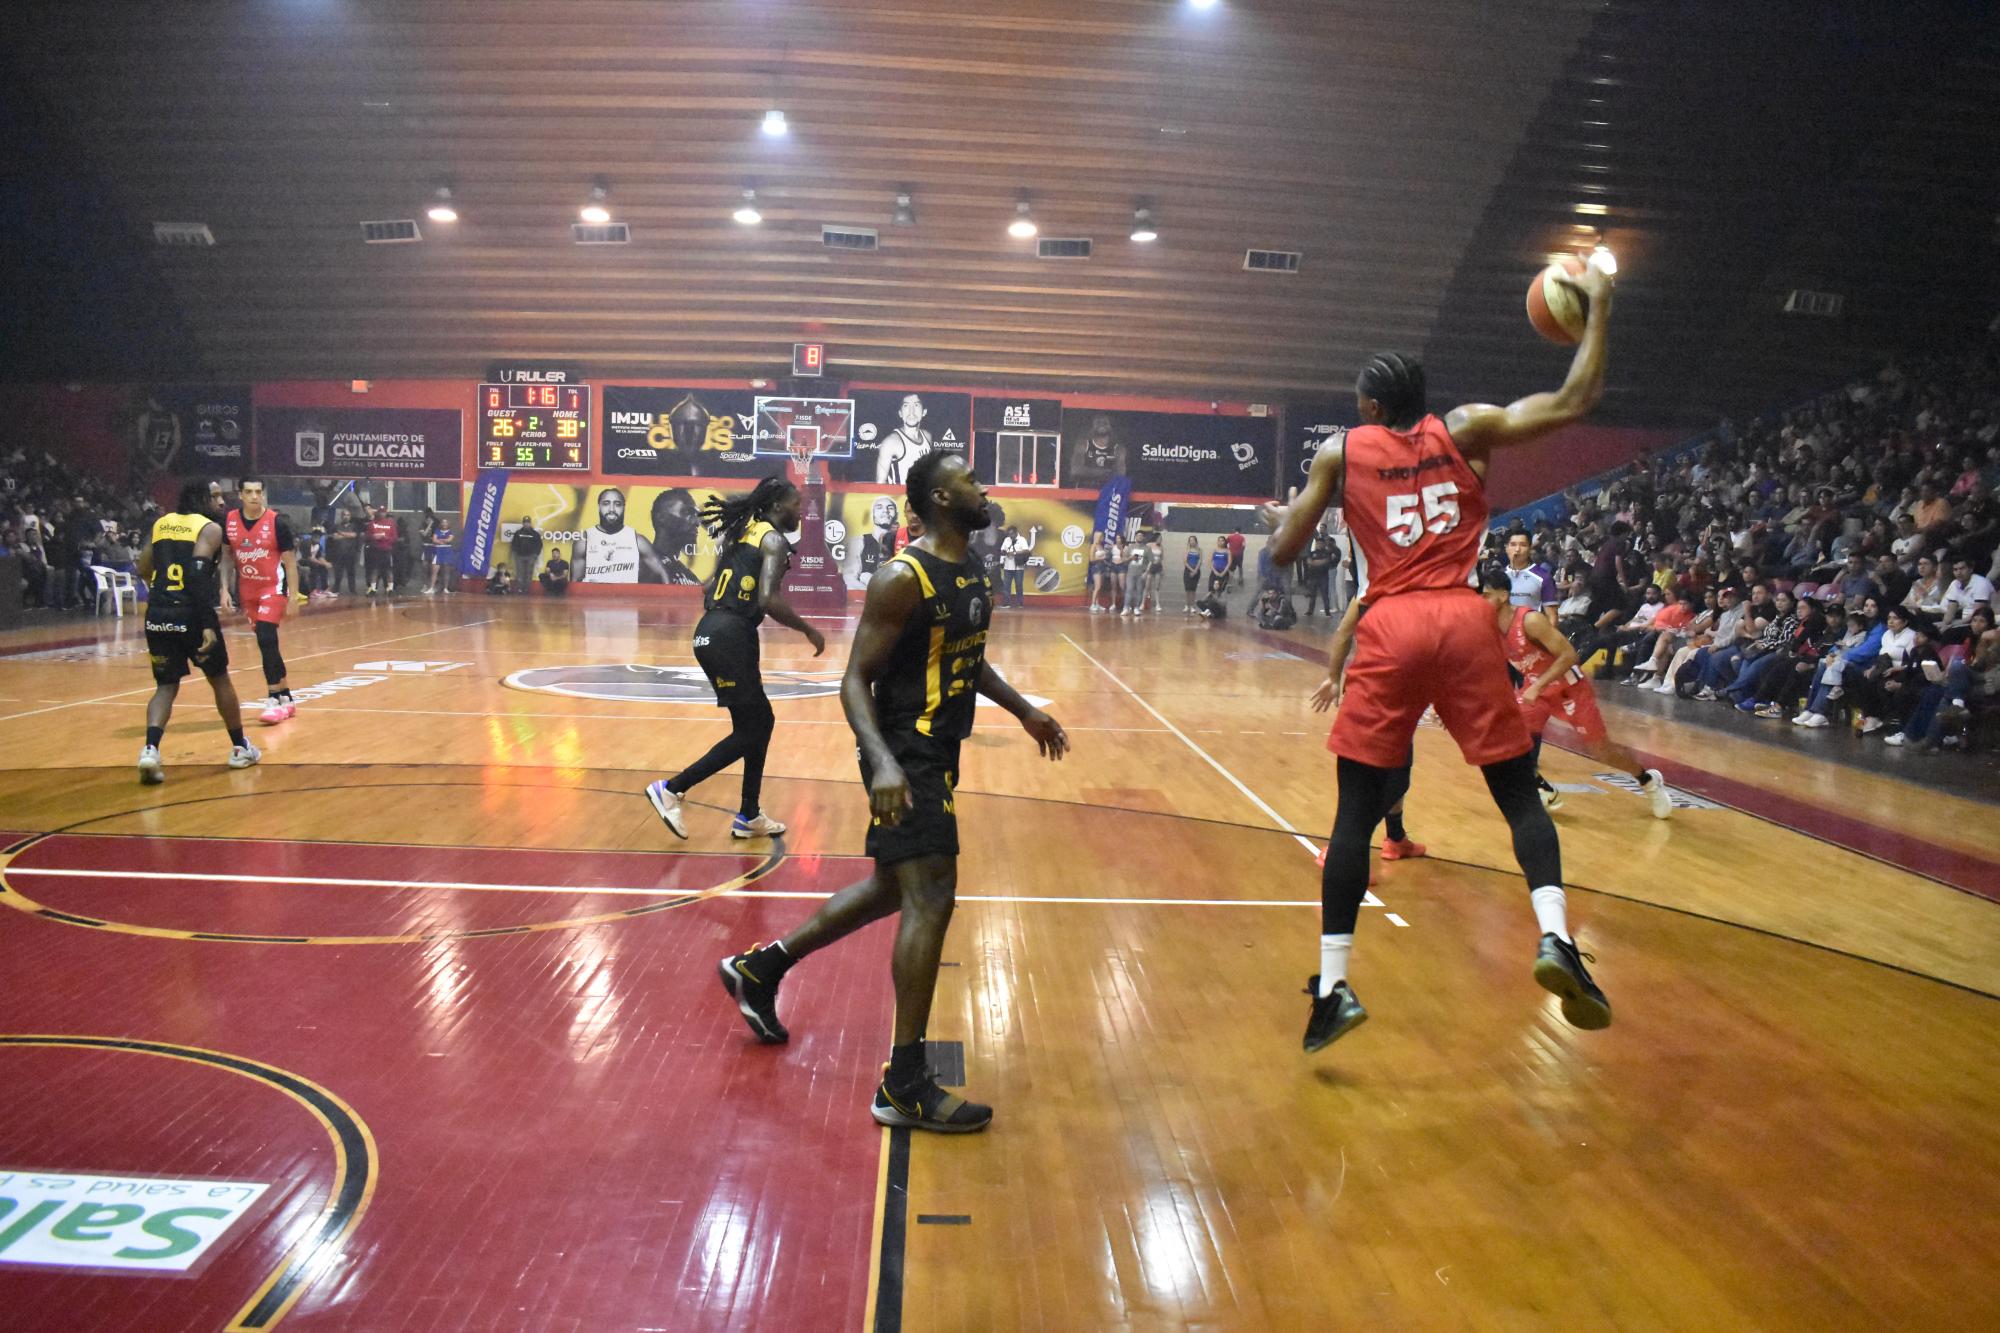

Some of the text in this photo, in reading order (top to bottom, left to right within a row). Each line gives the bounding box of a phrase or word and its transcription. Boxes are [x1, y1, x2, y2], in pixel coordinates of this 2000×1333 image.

[807, 347, 819, 365] 8
[516, 370, 566, 383] RULER
[490, 393, 500, 408] 0
[527, 386, 556, 405] 1:16
[487, 409, 517, 418] GUEST
[552, 410, 580, 419] HOME
[1004, 403, 1030, 417] ASÍ
[529, 416, 538, 430] 2
[611, 411, 652, 425] IMJU
[492, 418, 515, 437] 26
[556, 419, 578, 438] 38
[332, 432, 425, 443] AYUNTAMIENTO DE
[332, 442, 425, 458] CULIACÁN
[491, 446, 502, 461] 3
[516, 447, 534, 461] 55
[568, 448, 579, 462] 4
[1142, 443, 1217, 462] SaludDigna
[1386, 481, 1461, 547] 55
[470, 483, 497, 571] dportenis
[806, 556, 825, 564] ISDE
[1063, 553, 1083, 565] LG
[166, 563, 185, 591] 9
[713, 568, 733, 600] 0
[737, 589, 751, 601] LG
[146, 620, 188, 633] SoniGas
[30, 1177, 76, 1190] es
[84, 1180, 193, 1197] salud
[206, 1186, 256, 1203] La
